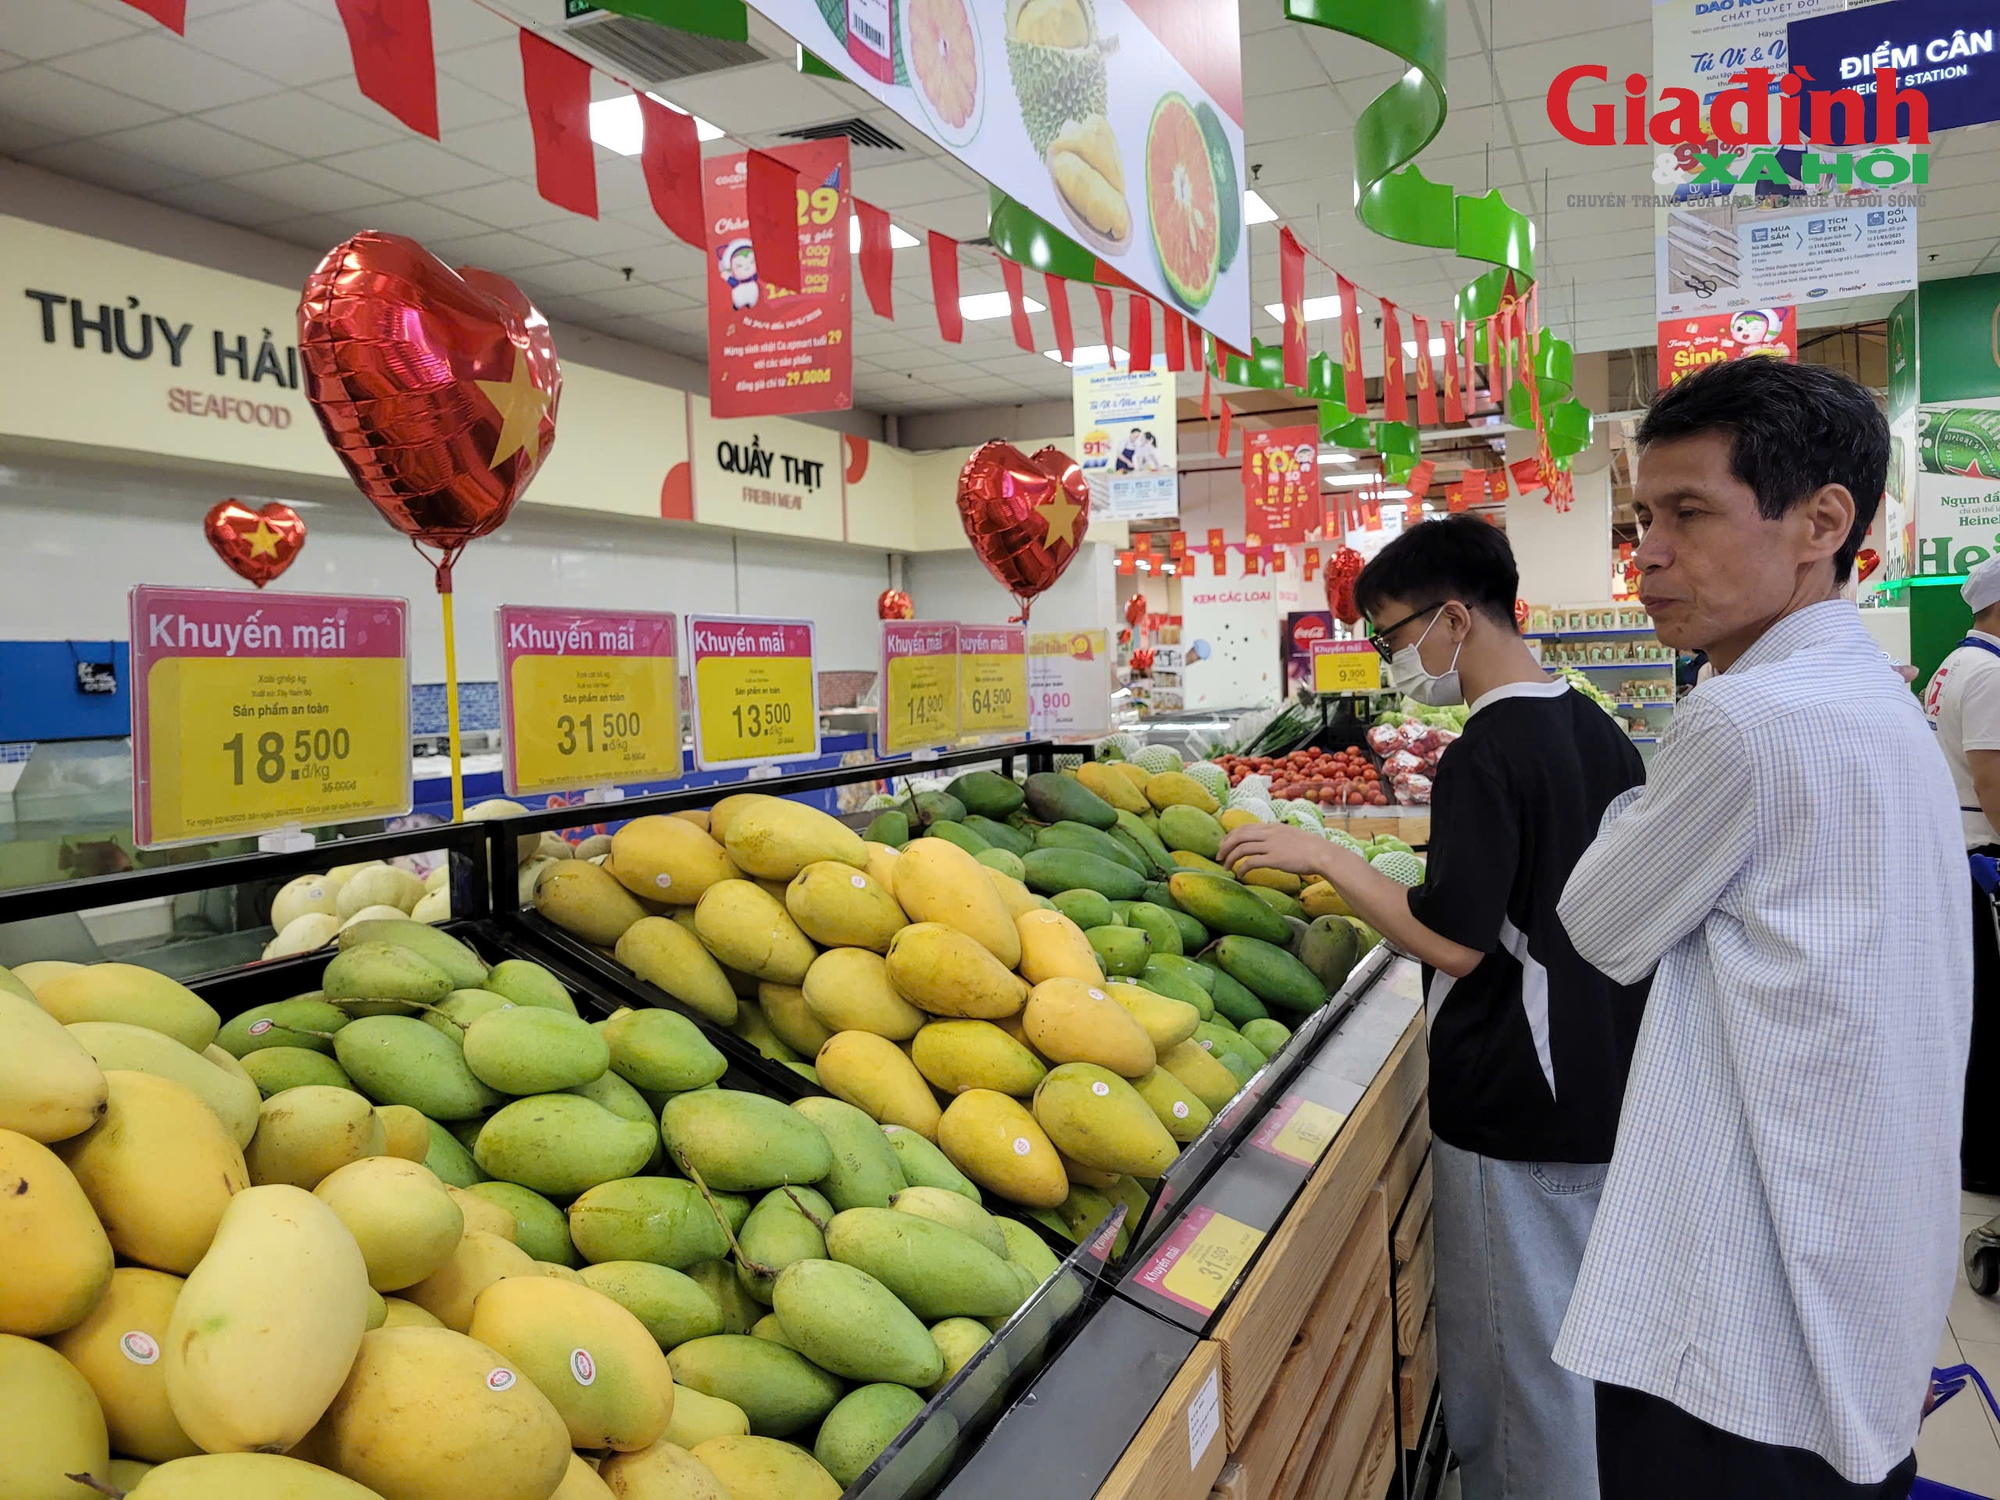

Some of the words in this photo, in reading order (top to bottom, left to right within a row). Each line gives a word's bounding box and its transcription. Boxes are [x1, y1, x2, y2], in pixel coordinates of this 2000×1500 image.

[1756, 3, 1792, 17] TUYỆT
[1719, 47, 1748, 66] Vi
[1750, 47, 1764, 61] &
[1839, 40, 1918, 80] ĐIỂM
[1925, 29, 1993, 64] CÂN
[1842, 76, 1901, 96] WEIGT
[1904, 64, 1968, 87] STATION
[1770, 224, 1791, 233] MUA
[1827, 216, 1848, 225] TÍCH
[1827, 224, 1847, 233] TEM
[25, 289, 193, 367] THỦY
[213, 328, 298, 390] HẢI
[827, 329, 842, 344] 29
[167, 387, 292, 430] SEAFOOD
[780, 453, 824, 494] THỊT
[1941, 496, 1980, 508] Ngụm
[1193, 592, 1216, 605] KEM
[1219, 590, 1242, 602] CÁC
[150, 610, 282, 656] Khuyến
[293, 617, 346, 649] mãi
[510, 620, 593, 656] Khuyến
[600, 626, 634, 651] mãi
[695, 627, 756, 657] Khuyến
[759, 632, 786, 652] mãi
[887, 630, 924, 657] Khuyến
[926, 632, 942, 651] mãi
[990, 631, 1008, 650] mãi
[1314, 645, 1345, 654] Khuyến
[1346, 643, 1362, 652] mãi
[233, 704, 255, 717] Sản
[258, 702, 288, 718] phẩm
[291, 705, 304, 714] an
[307, 702, 329, 714] toàn
[731, 703, 791, 738] 13.500
[557, 712, 641, 755] 31.500
[223, 727, 349, 786] 18.500
[1143, 1258, 1172, 1283] Khuyến
[1165, 1245, 1181, 1260] mãi
